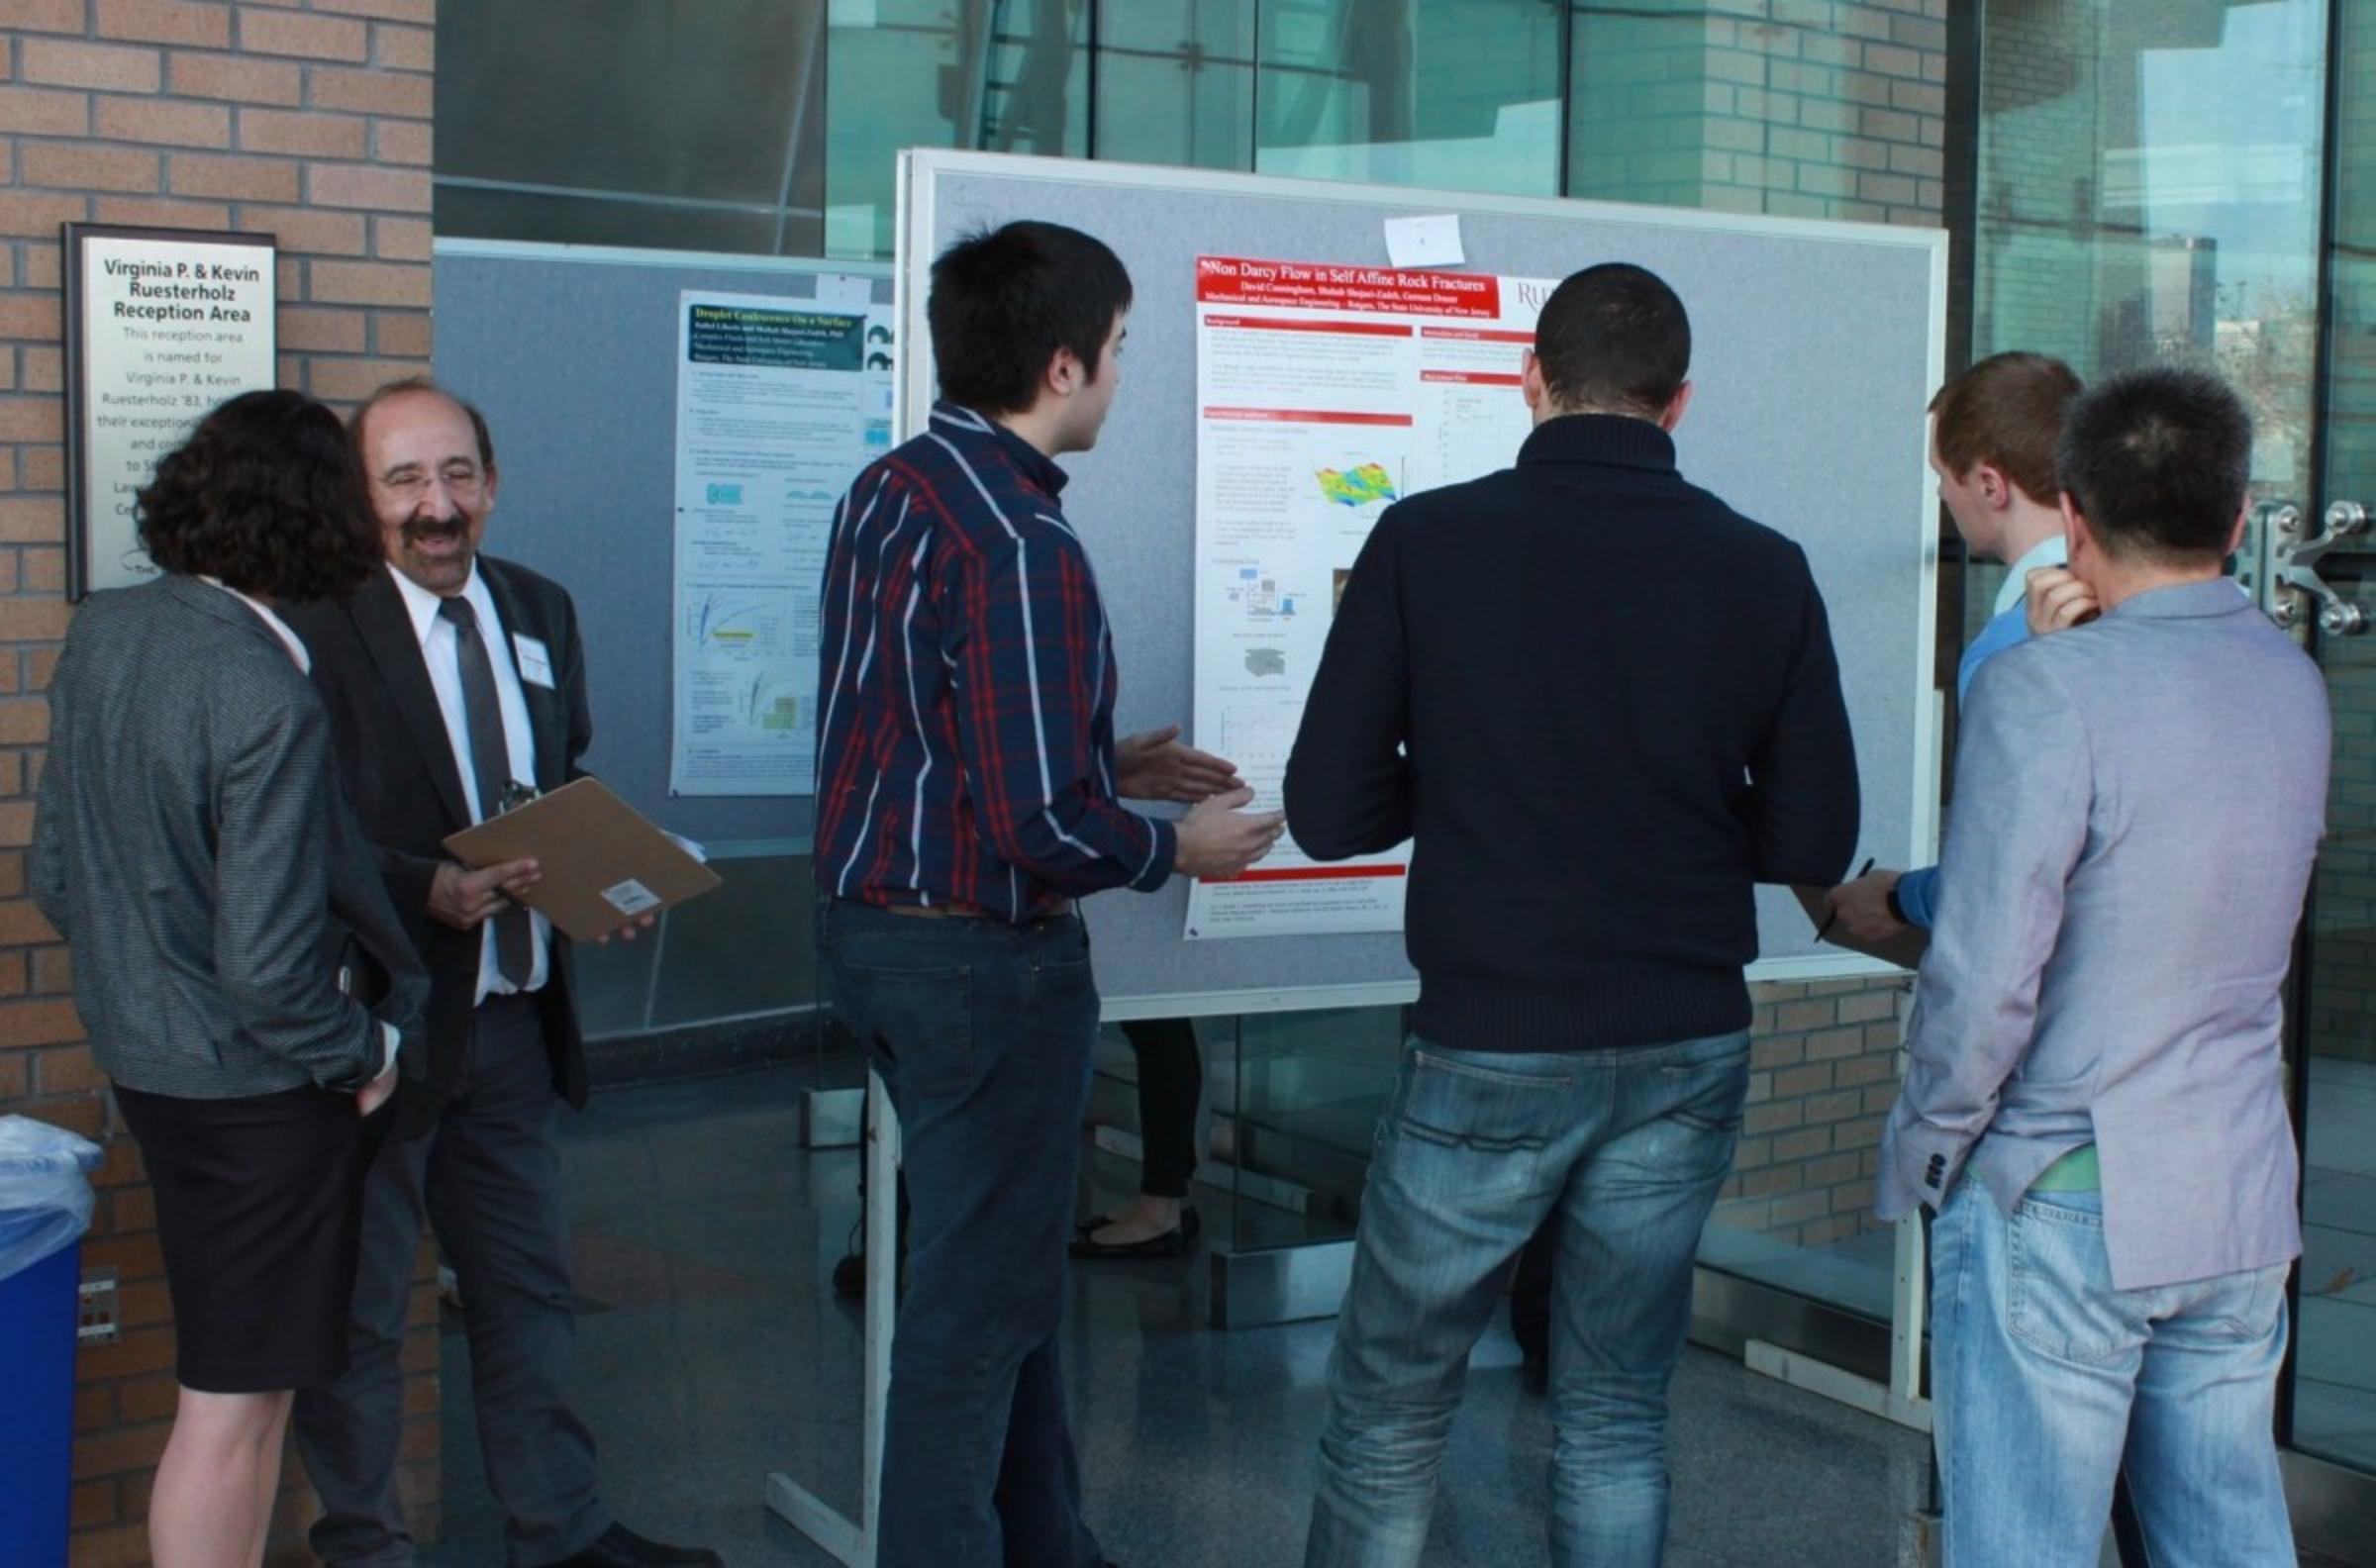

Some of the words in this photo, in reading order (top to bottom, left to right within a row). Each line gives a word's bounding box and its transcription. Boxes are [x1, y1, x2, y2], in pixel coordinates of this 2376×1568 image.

[104, 259, 173, 280] Virginia
[177, 262, 190, 278] P.
[195, 263, 207, 279] &
[212, 264, 260, 282] Kevin
[1211, 261, 1237, 276] Non
[1240, 263, 1277, 281] Darcy
[1281, 265, 1312, 280] Flow
[1315, 268, 1328, 281] in
[1331, 269, 1354, 283] Self
[1357, 271, 1394, 286] Affine
[1398, 273, 1429, 288] Rock
[1432, 276, 1486, 292] Fractures
[130, 282, 237, 301] Ruesterholz
[1240, 281, 1264, 292] David
[114, 301, 204, 322] Reception
[210, 306, 251, 322] Area
[124, 328, 148, 341] This
[151, 330, 213, 346] reception
[214, 333, 244, 343] area
[145, 351, 153, 362] is
[157, 351, 201, 363] named
[204, 352, 223, 363] for
[126, 371, 176, 387] Virginia
[193, 373, 203, 385] &
[207, 373, 242, 386] Kevin
[102, 393, 177, 407] Ruesterholz
[98, 416, 127, 428] their
[130, 439, 155, 450] and
[126, 459, 141, 472] to
